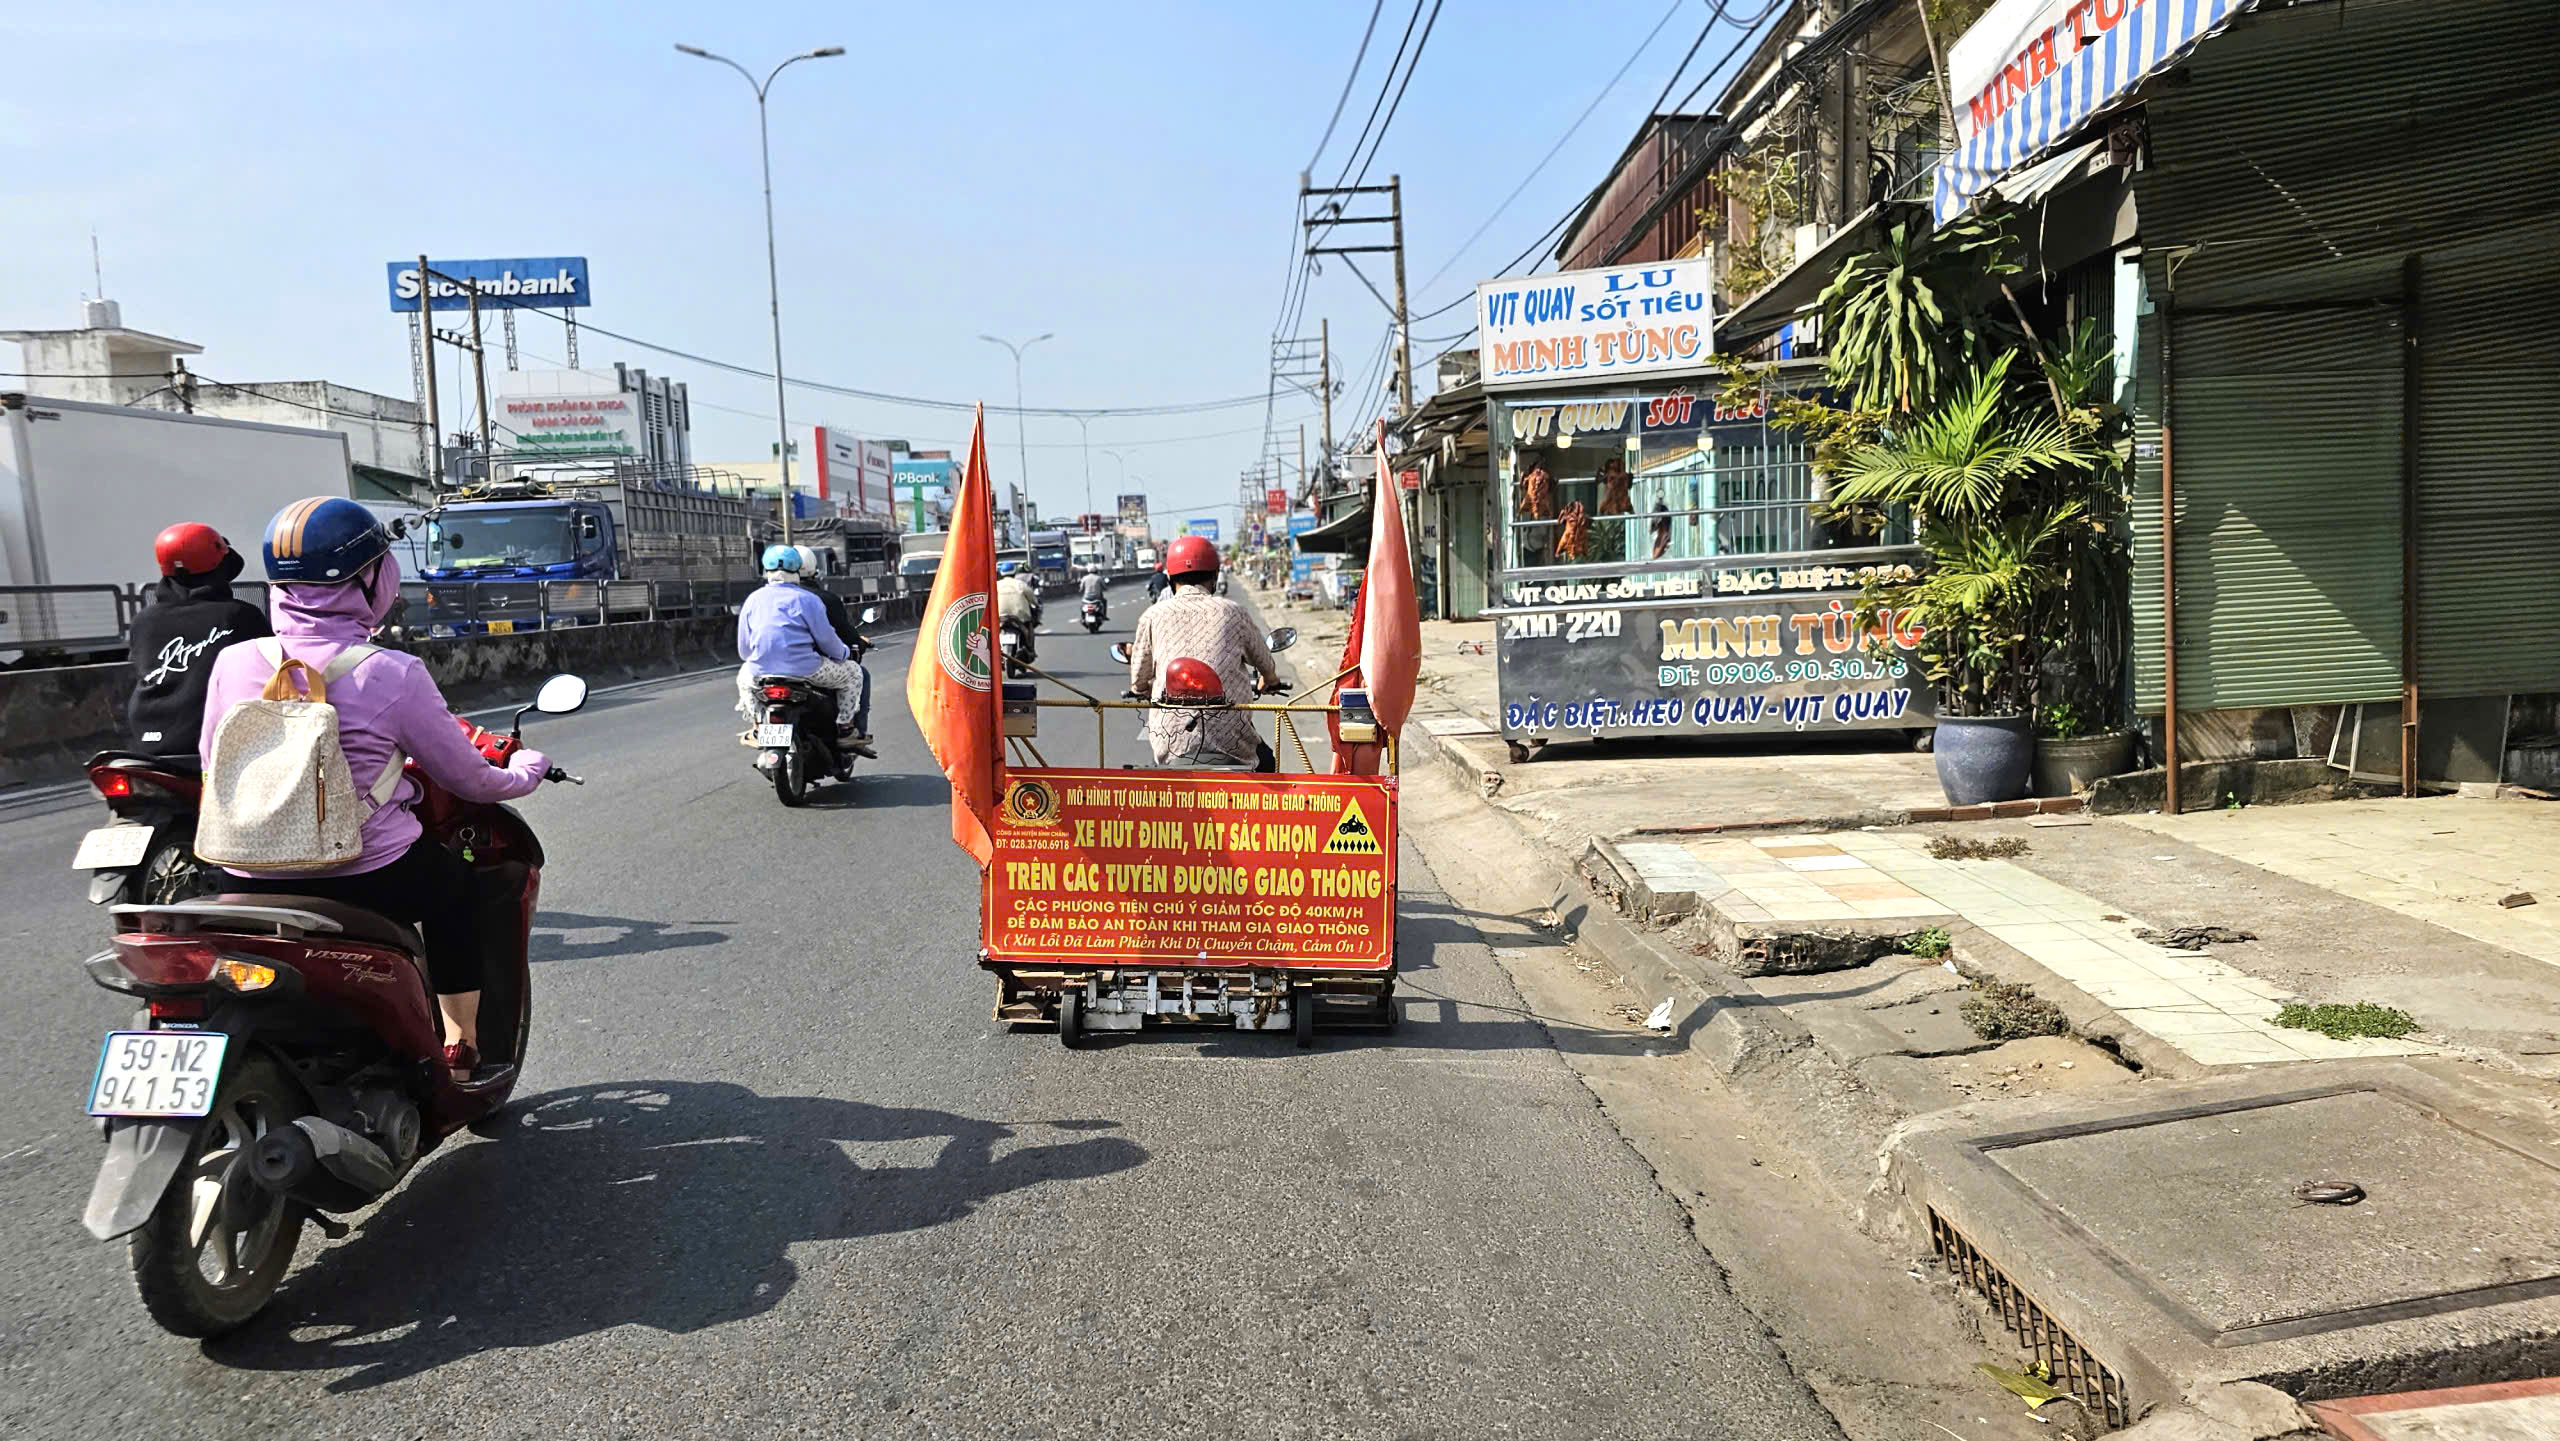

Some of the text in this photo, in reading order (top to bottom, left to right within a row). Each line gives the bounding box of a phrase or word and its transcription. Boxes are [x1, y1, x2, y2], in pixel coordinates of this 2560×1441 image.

[1969, 26, 2059, 138] MINH
[1604, 268, 1677, 293] LU
[1488, 286, 1703, 333] VỊT QUAY SỐT TIÊU
[1493, 320, 1701, 377] MINH TÙNG
[1513, 407, 1555, 445] VỊT
[1558, 400, 1628, 436] QUAY
[1646, 386, 1696, 427] SỐT
[1511, 587, 1541, 606] VỊT
[1545, 584, 1601, 604] QUAY
[1717, 570, 1774, 595] ĐẶC
[1660, 600, 1927, 660] MINH TÙNG
[1658, 666, 1700, 687] ĐT:
[1507, 696, 1559, 735] ĐẶC
[1630, 697, 1685, 727] HEO
[1833, 688, 1911, 723] QUAY
[1067, 784, 1341, 813] MÔ HÌNH TỰ QUẢN HỖ TRỢ NGƯỜI THAM GIA GIAO THÔNG
[996, 838, 1070, 850] ĐT: 028.3760.6918
[1073, 813, 1317, 859] XE HÚT ĐINH, VẬT SẮC NHỌN
[1006, 856, 1381, 898] TRÊN CÁC TUYẾN ĐƯỜNG GIAO THÔNG
[1007, 912, 1369, 936] ĐỂ ĐẢM BẢO AN TOÀN KHI THAM GIA GIAO THÔNG
[1014, 897, 1363, 920] CÁC PHƯƠNG TIỆN CHÚ Ý GIẢM TỐC ĐỘ 40KM/H
[304, 948, 373, 961] VISION
[1012, 934, 1036, 947] Xin
[1040, 932, 1060, 947] Lỗi
[1063, 934, 1083, 948] Đã
[1086, 934, 1115, 948] Làm
[1118, 933, 1156, 949] Phiền
[1160, 935, 1182, 949] Khi
[1186, 937, 1200, 949] Di
[1203, 935, 1252, 953] Chuyển
[1256, 938, 1298, 954] Chậm,
[1302, 938, 1332, 952] Cảm
[1335, 940, 1355, 952] Ơn
[121, 1039, 208, 1072] 59-N2
[100, 1076, 210, 1109] 941.53
